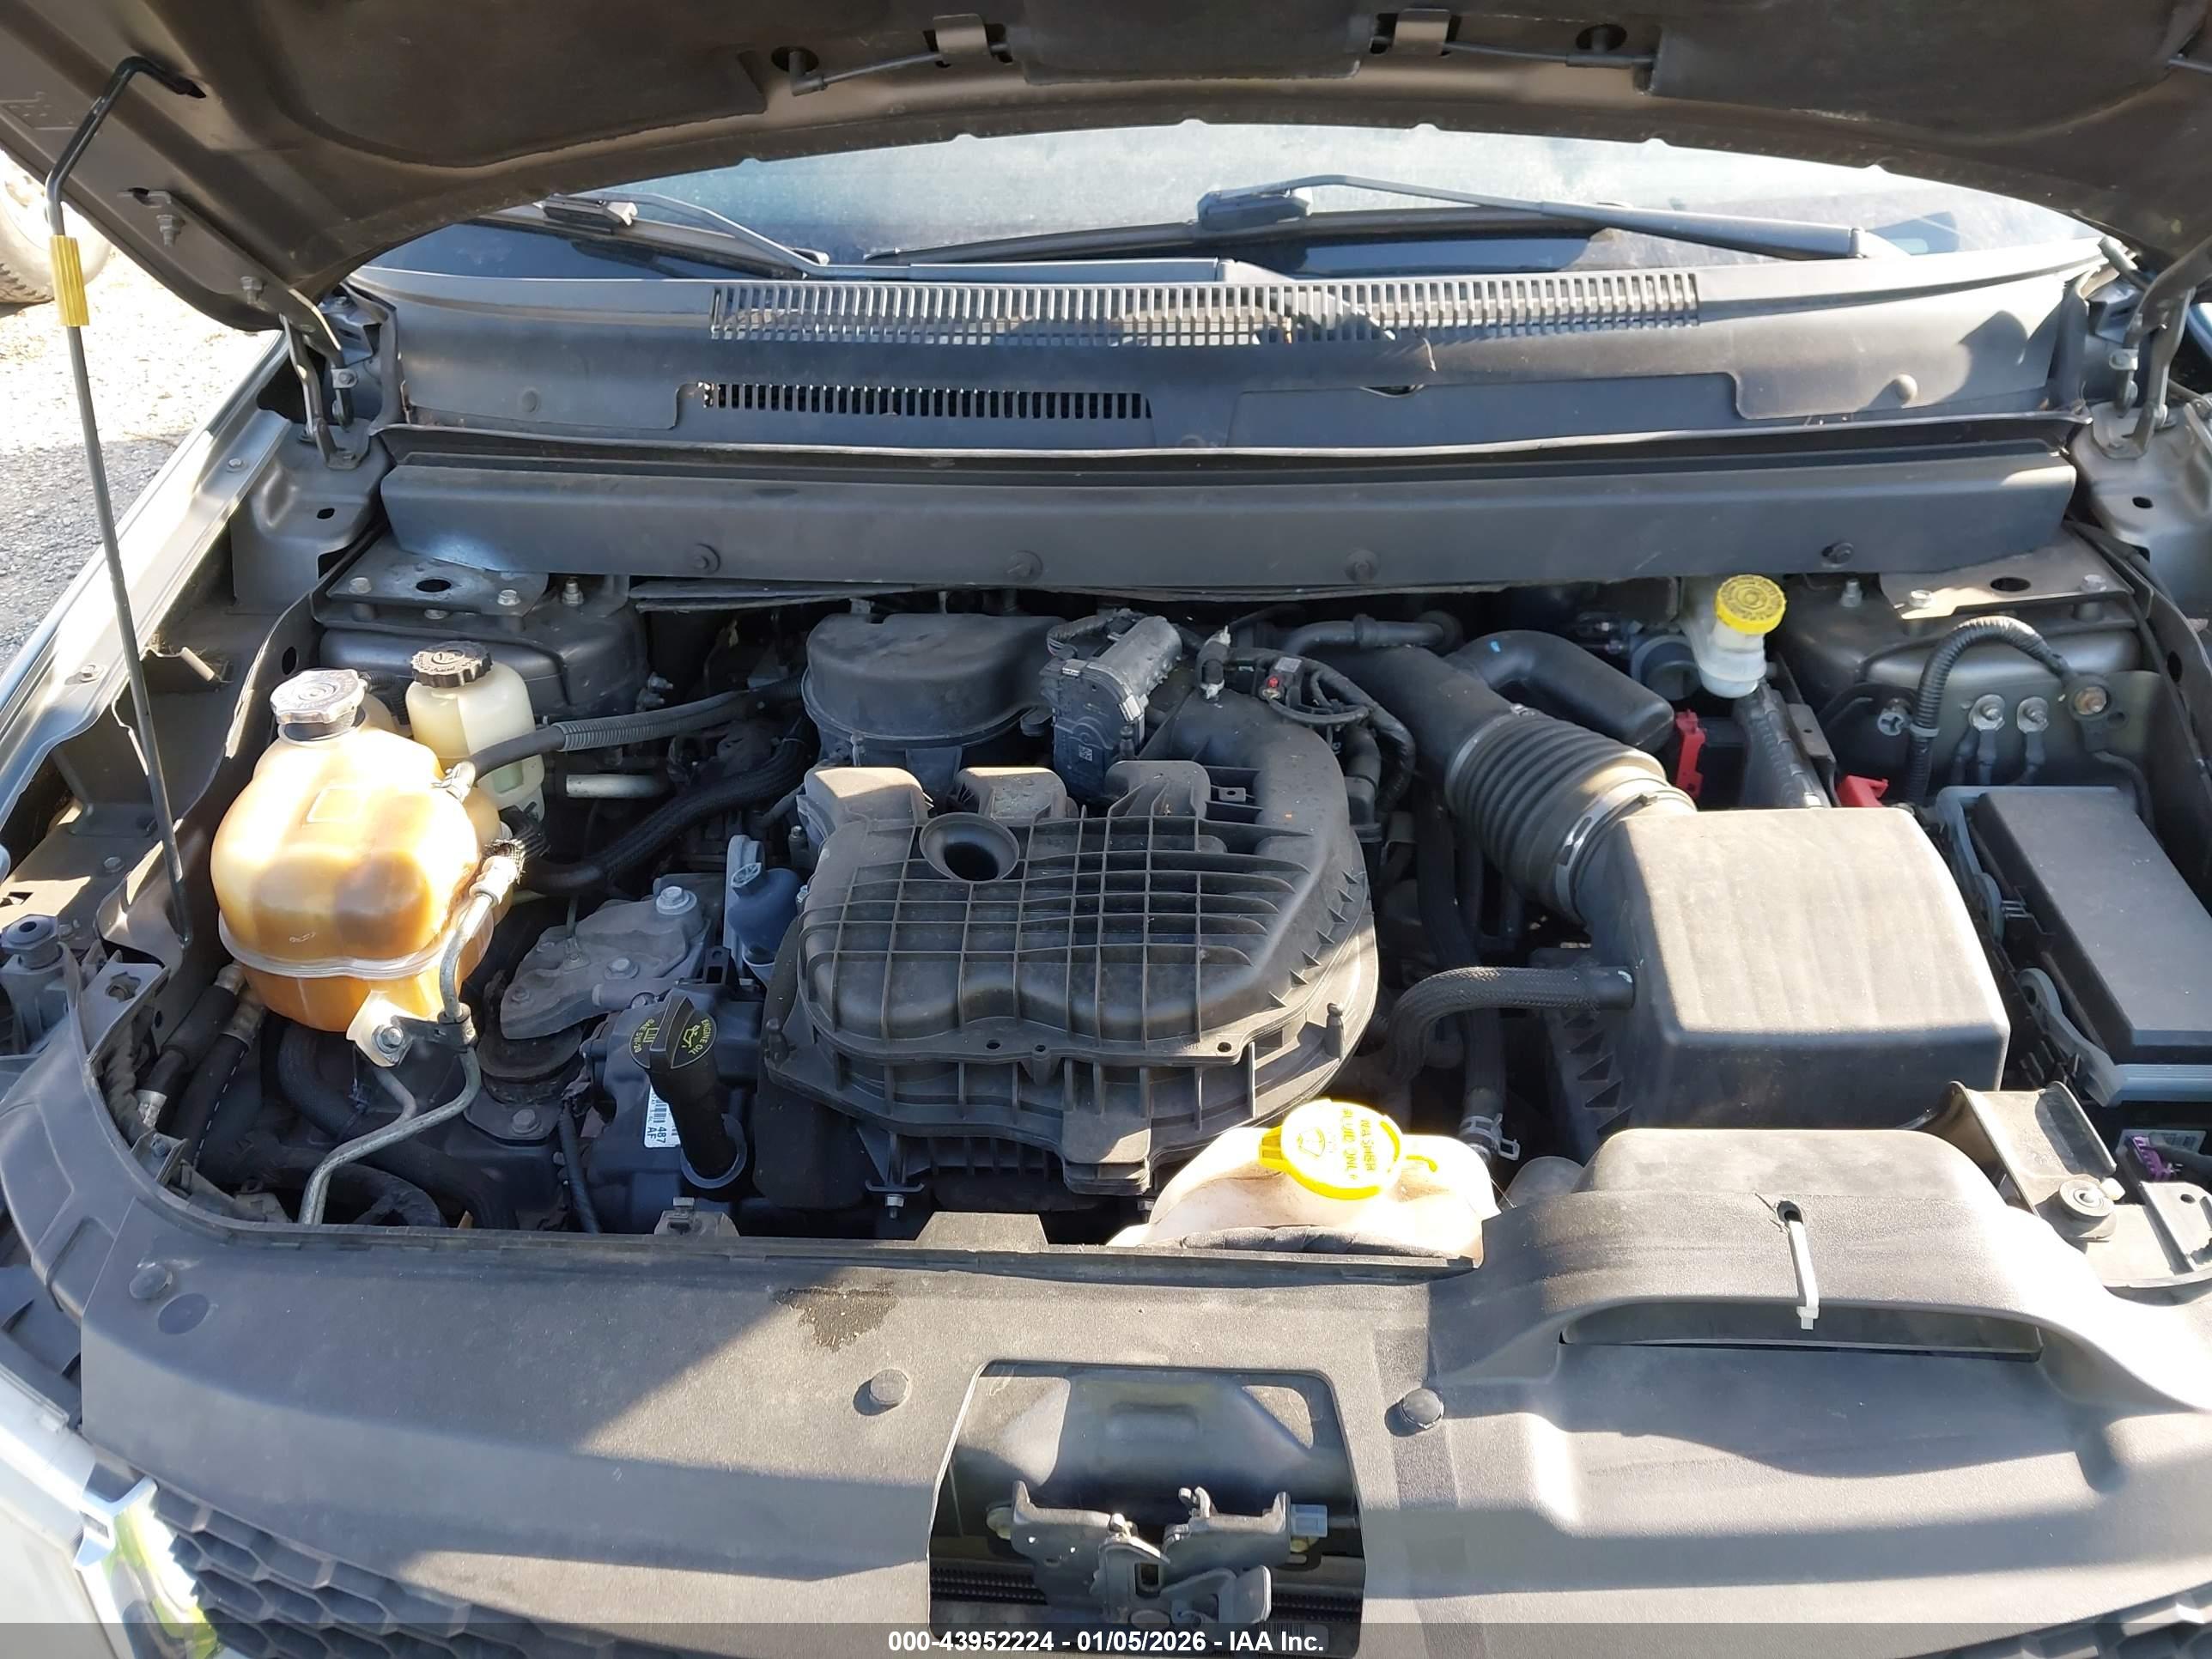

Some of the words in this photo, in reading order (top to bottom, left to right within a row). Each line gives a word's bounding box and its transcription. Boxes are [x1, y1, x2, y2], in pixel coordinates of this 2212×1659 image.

[639, 1018, 654, 1031] SAE
[699, 1018, 712, 1044] ENGINE
[633, 1031, 643, 1054] 5W-20
[687, 1043, 703, 1054] OIL
[647, 1127, 658, 1139] AF
[656, 1126, 667, 1144] 487
